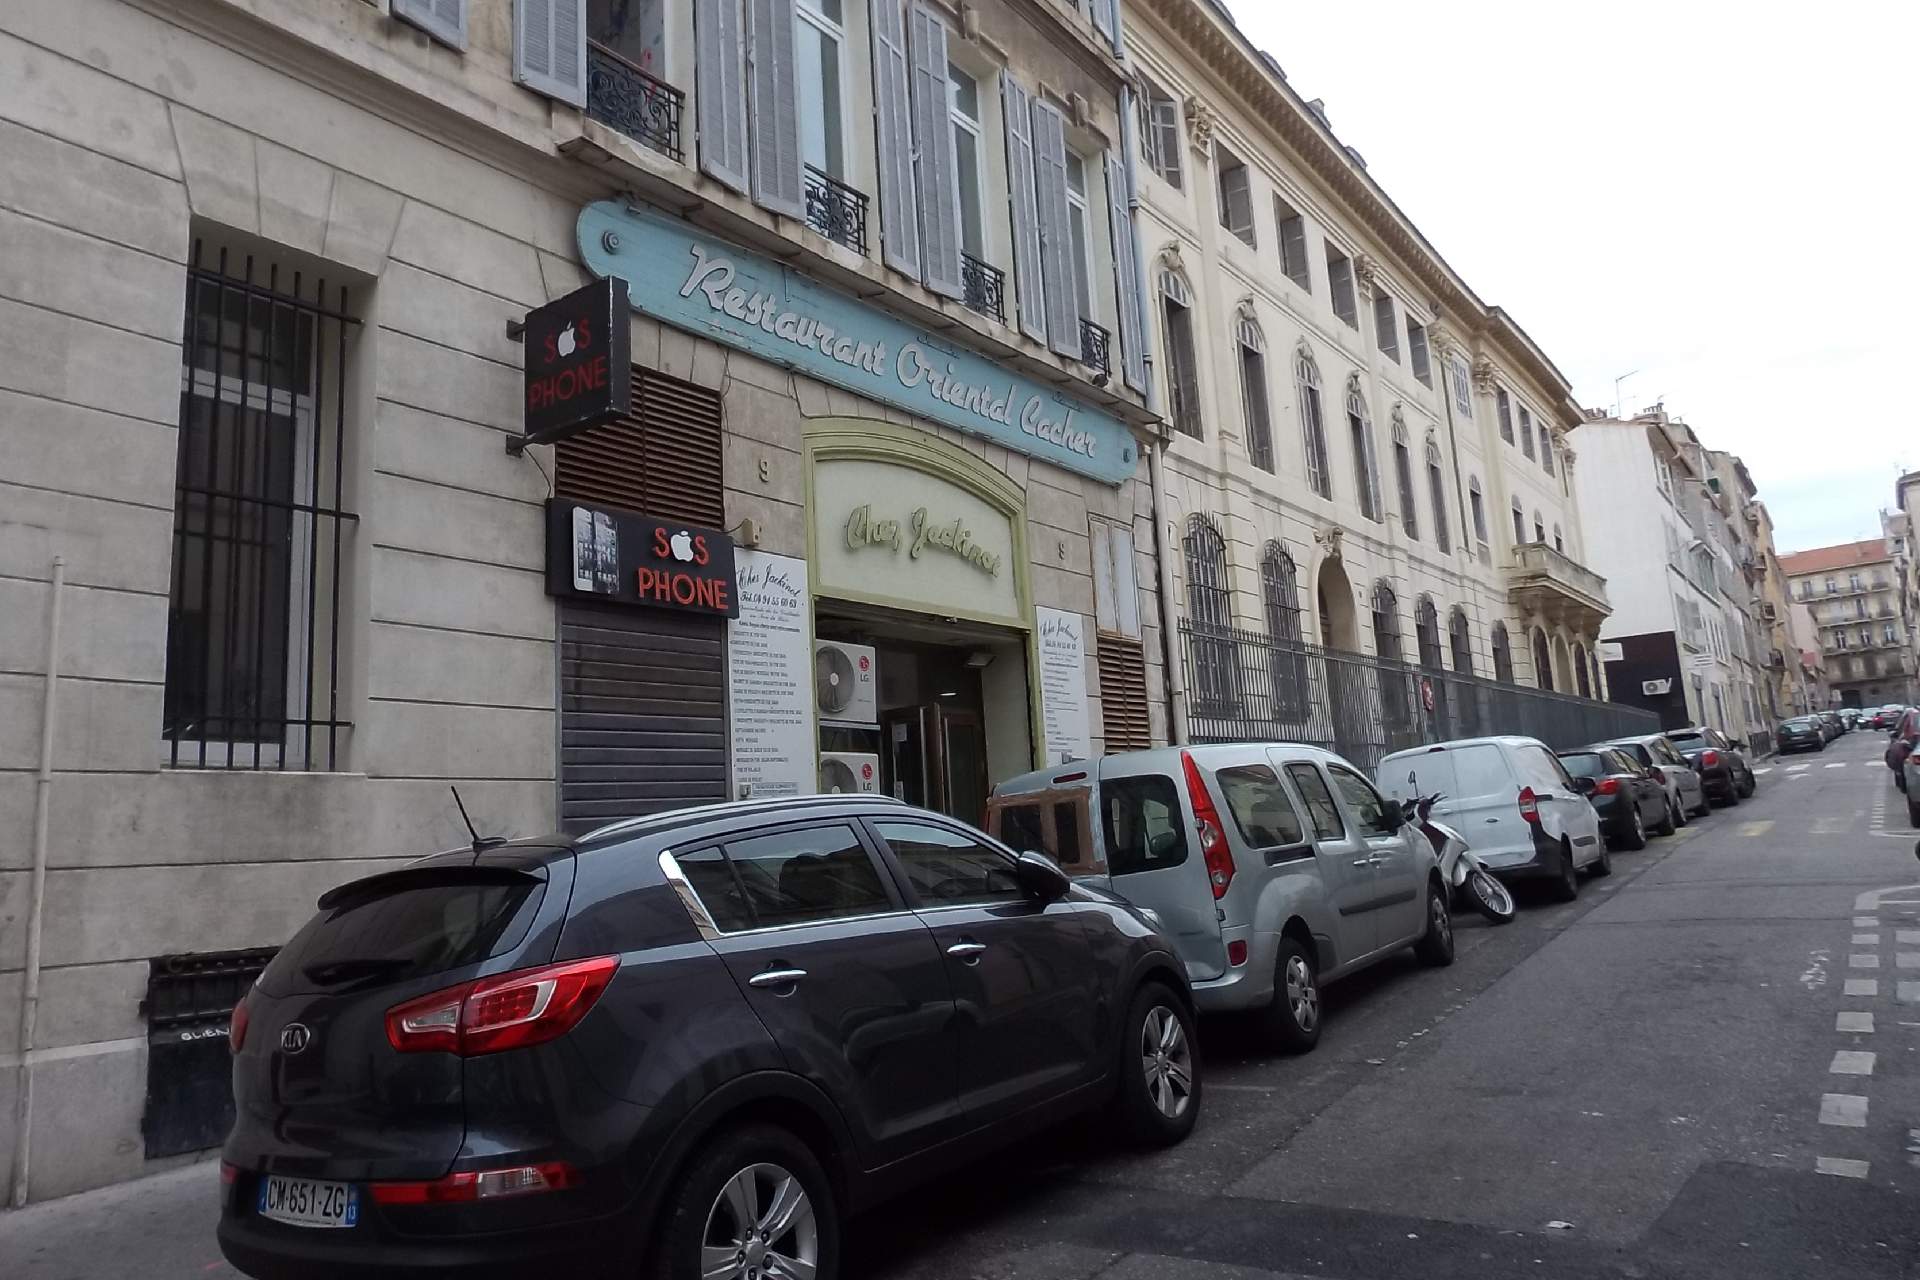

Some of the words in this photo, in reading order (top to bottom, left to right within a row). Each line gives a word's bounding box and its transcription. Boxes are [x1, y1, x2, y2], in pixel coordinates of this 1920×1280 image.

[679, 243, 887, 376] Restaurant
[895, 343, 1016, 426] Oriental
[1020, 395, 1097, 458] Cacher
[528, 353, 609, 412] PHONE
[845, 504, 900, 552] Chez
[638, 567, 729, 610] PHONE
[860, 674, 869, 682] LG
[862, 782, 872, 790] LG
[281, 1029, 303, 1049] KIA
